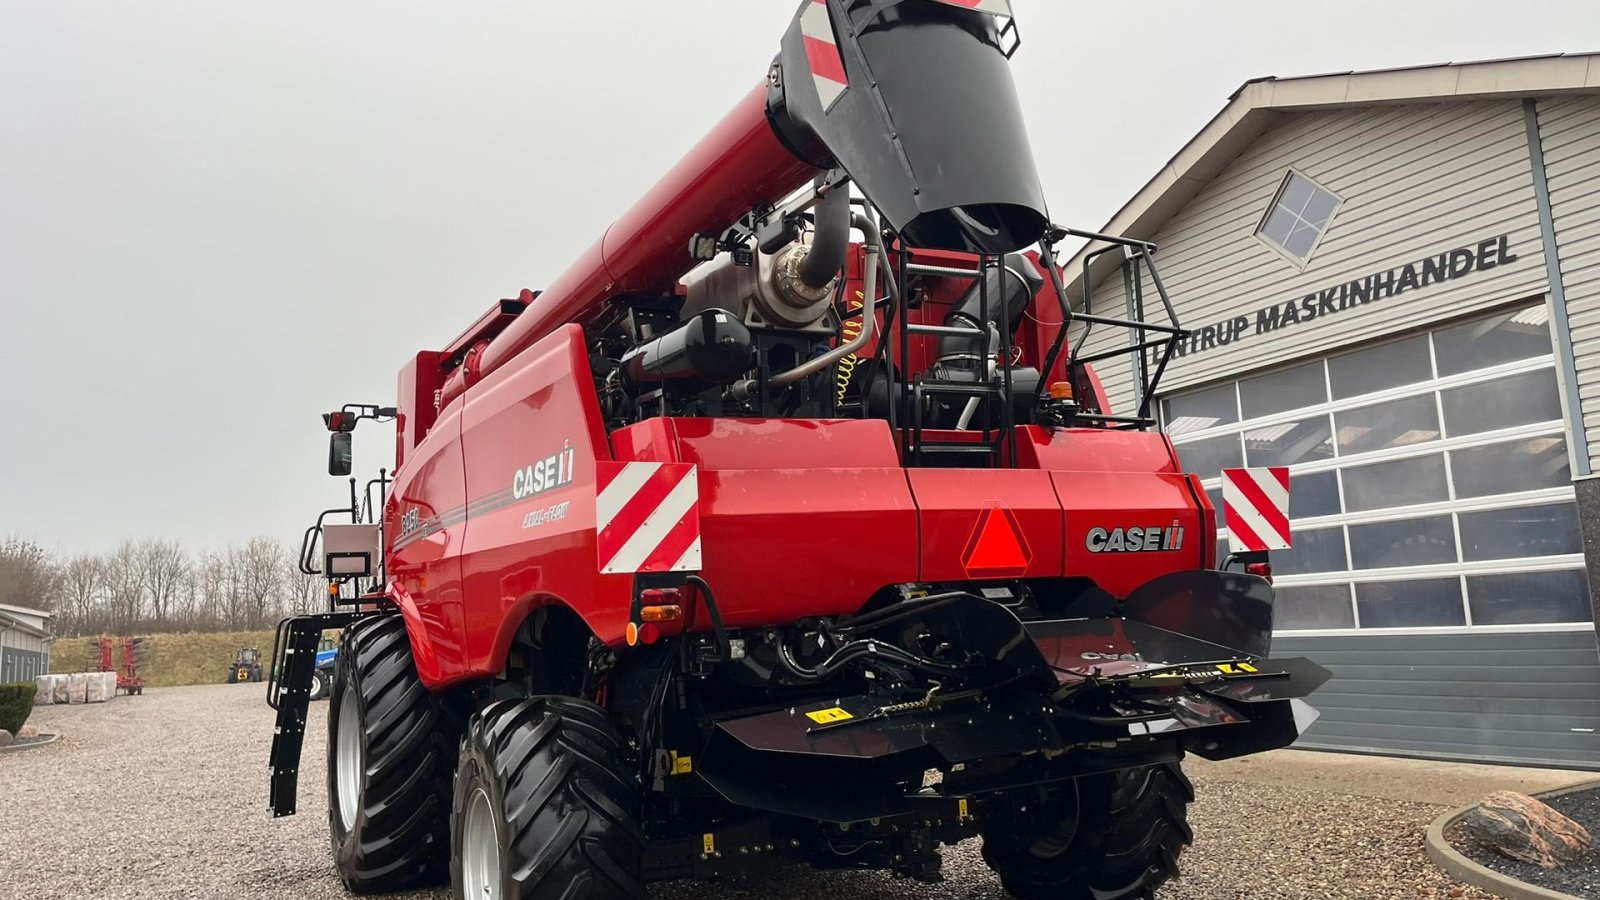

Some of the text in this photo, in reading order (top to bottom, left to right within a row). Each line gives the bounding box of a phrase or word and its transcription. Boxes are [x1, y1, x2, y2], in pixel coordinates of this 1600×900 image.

[1256, 235, 1518, 335] MASKINHANDEL
[513, 455, 557, 500] CASE
[1085, 526, 1161, 552] CASE
